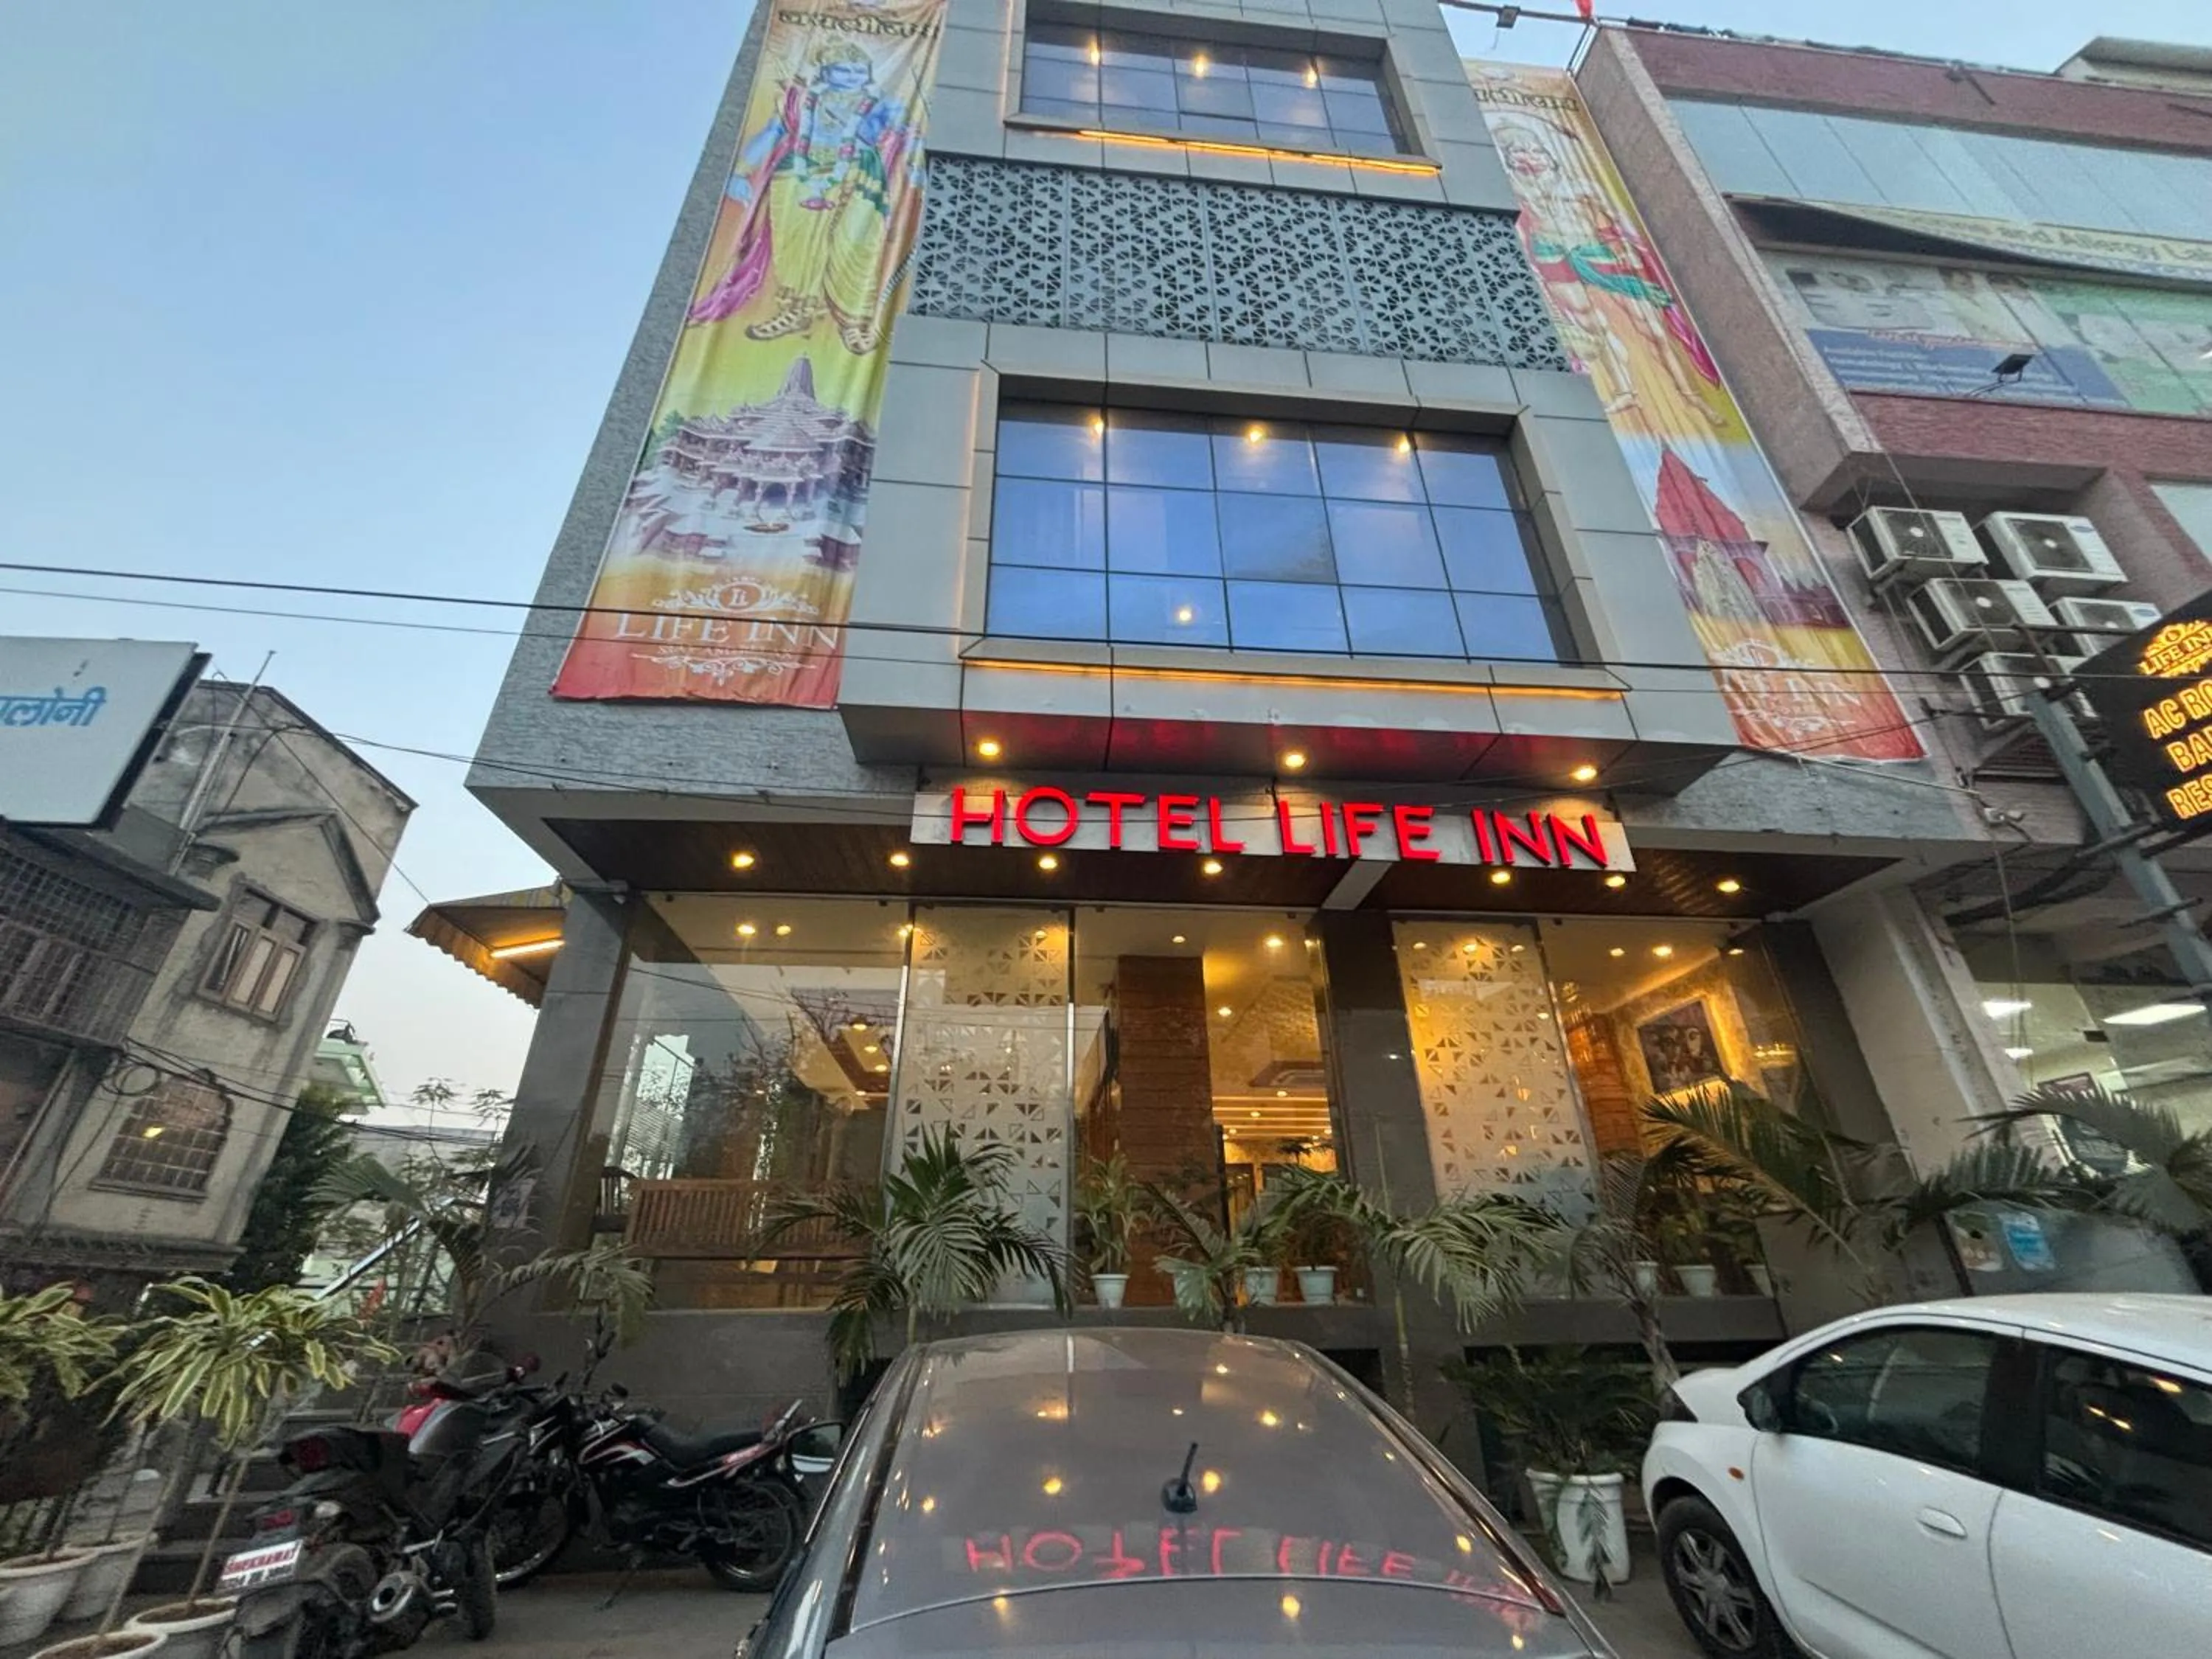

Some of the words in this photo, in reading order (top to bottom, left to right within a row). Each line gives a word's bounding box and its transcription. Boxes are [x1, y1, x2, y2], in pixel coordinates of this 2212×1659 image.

[615, 611, 731, 643] LIFE
[746, 616, 839, 650] INN
[2136, 644, 2185, 675] LIFE
[2143, 698, 2187, 740] AC
[950, 785, 1245, 853] HOTEL
[1278, 799, 1441, 862] LIFE
[1471, 807, 1608, 869] INN
